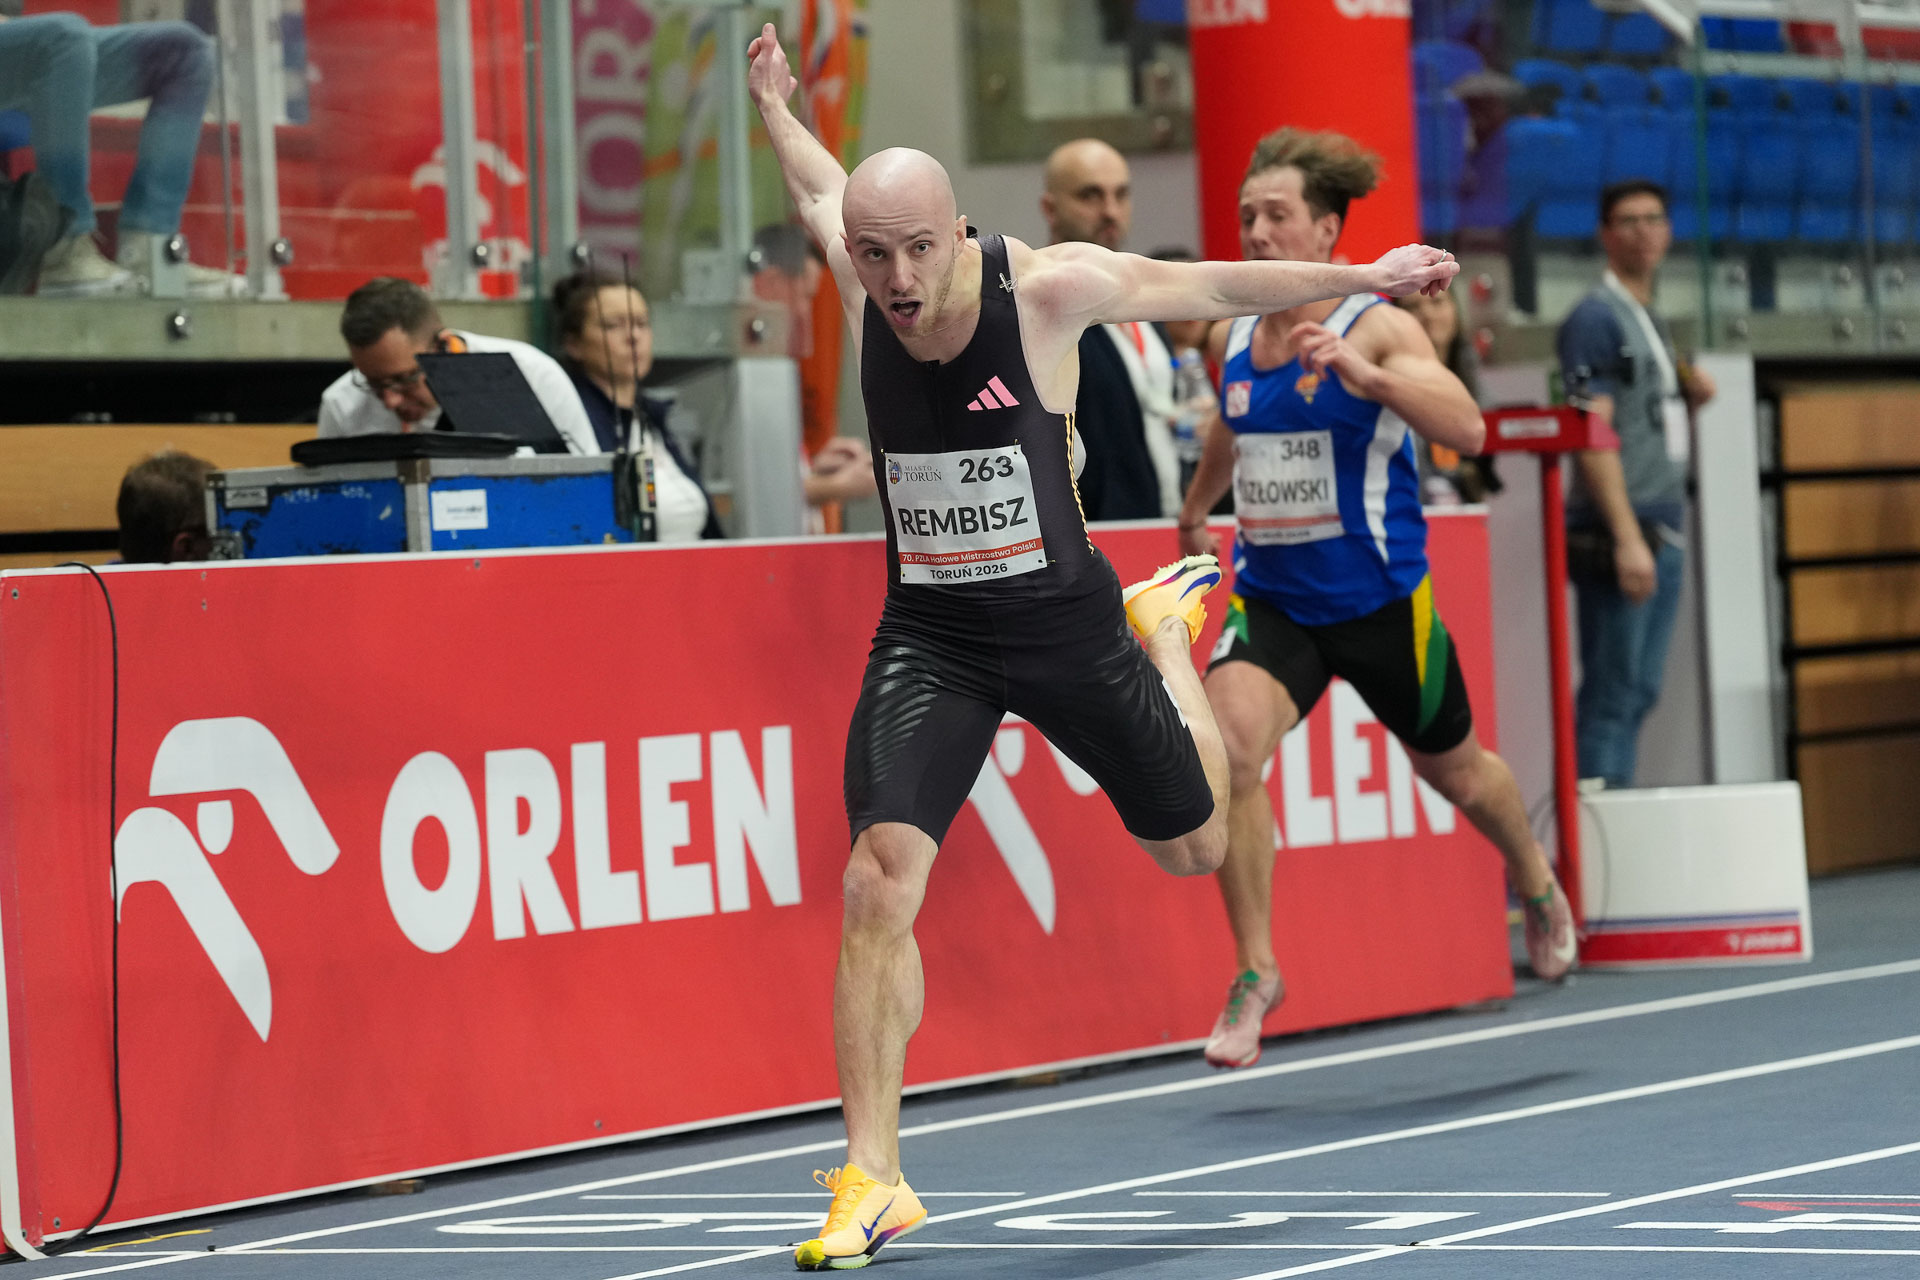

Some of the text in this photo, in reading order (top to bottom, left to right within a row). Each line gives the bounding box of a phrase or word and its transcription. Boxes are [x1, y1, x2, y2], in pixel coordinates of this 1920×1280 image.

[1281, 439, 1320, 460] 348
[904, 469, 942, 482] TORUŃ
[958, 455, 1015, 484] 263
[898, 496, 1028, 537] REMBISZ
[903, 541, 1036, 563] 70. PZLA Halowe Mistrzostwa Polski
[930, 563, 1008, 580] TORUŃ 2026
[1261, 680, 1456, 850] LEN
[380, 725, 802, 954] ORLEN
[993, 1210, 1480, 1230] 5
